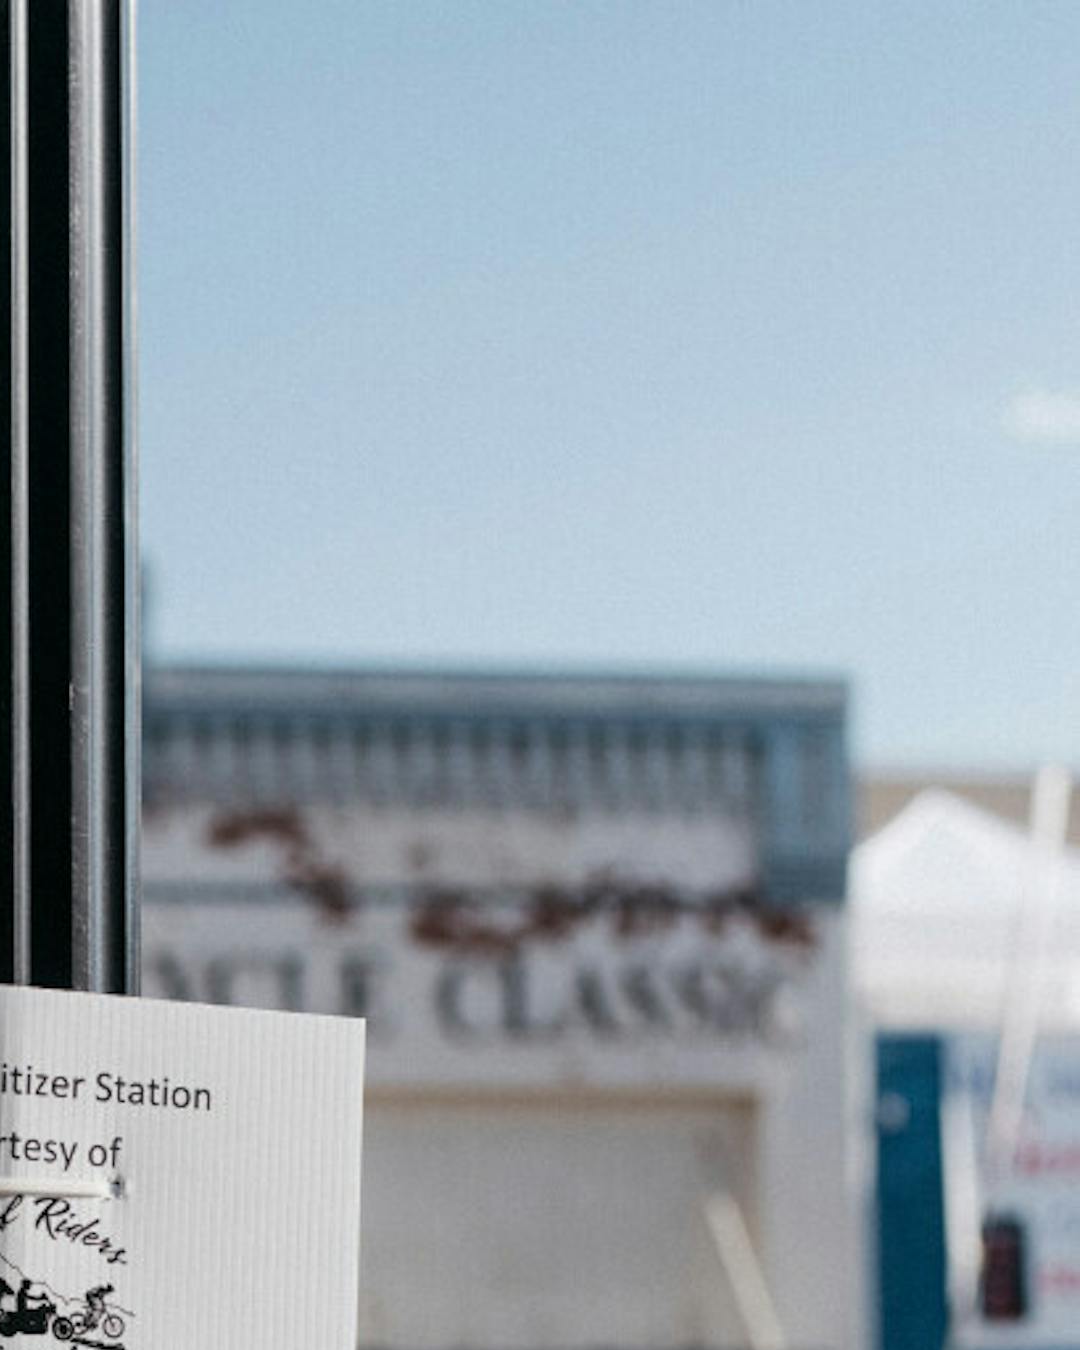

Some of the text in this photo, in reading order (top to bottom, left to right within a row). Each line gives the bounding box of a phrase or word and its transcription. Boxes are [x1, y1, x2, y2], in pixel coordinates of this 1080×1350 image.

[96, 1072, 213, 1112] Station
[88, 1136, 123, 1168] of
[33, 1196, 129, 1265] Riders
